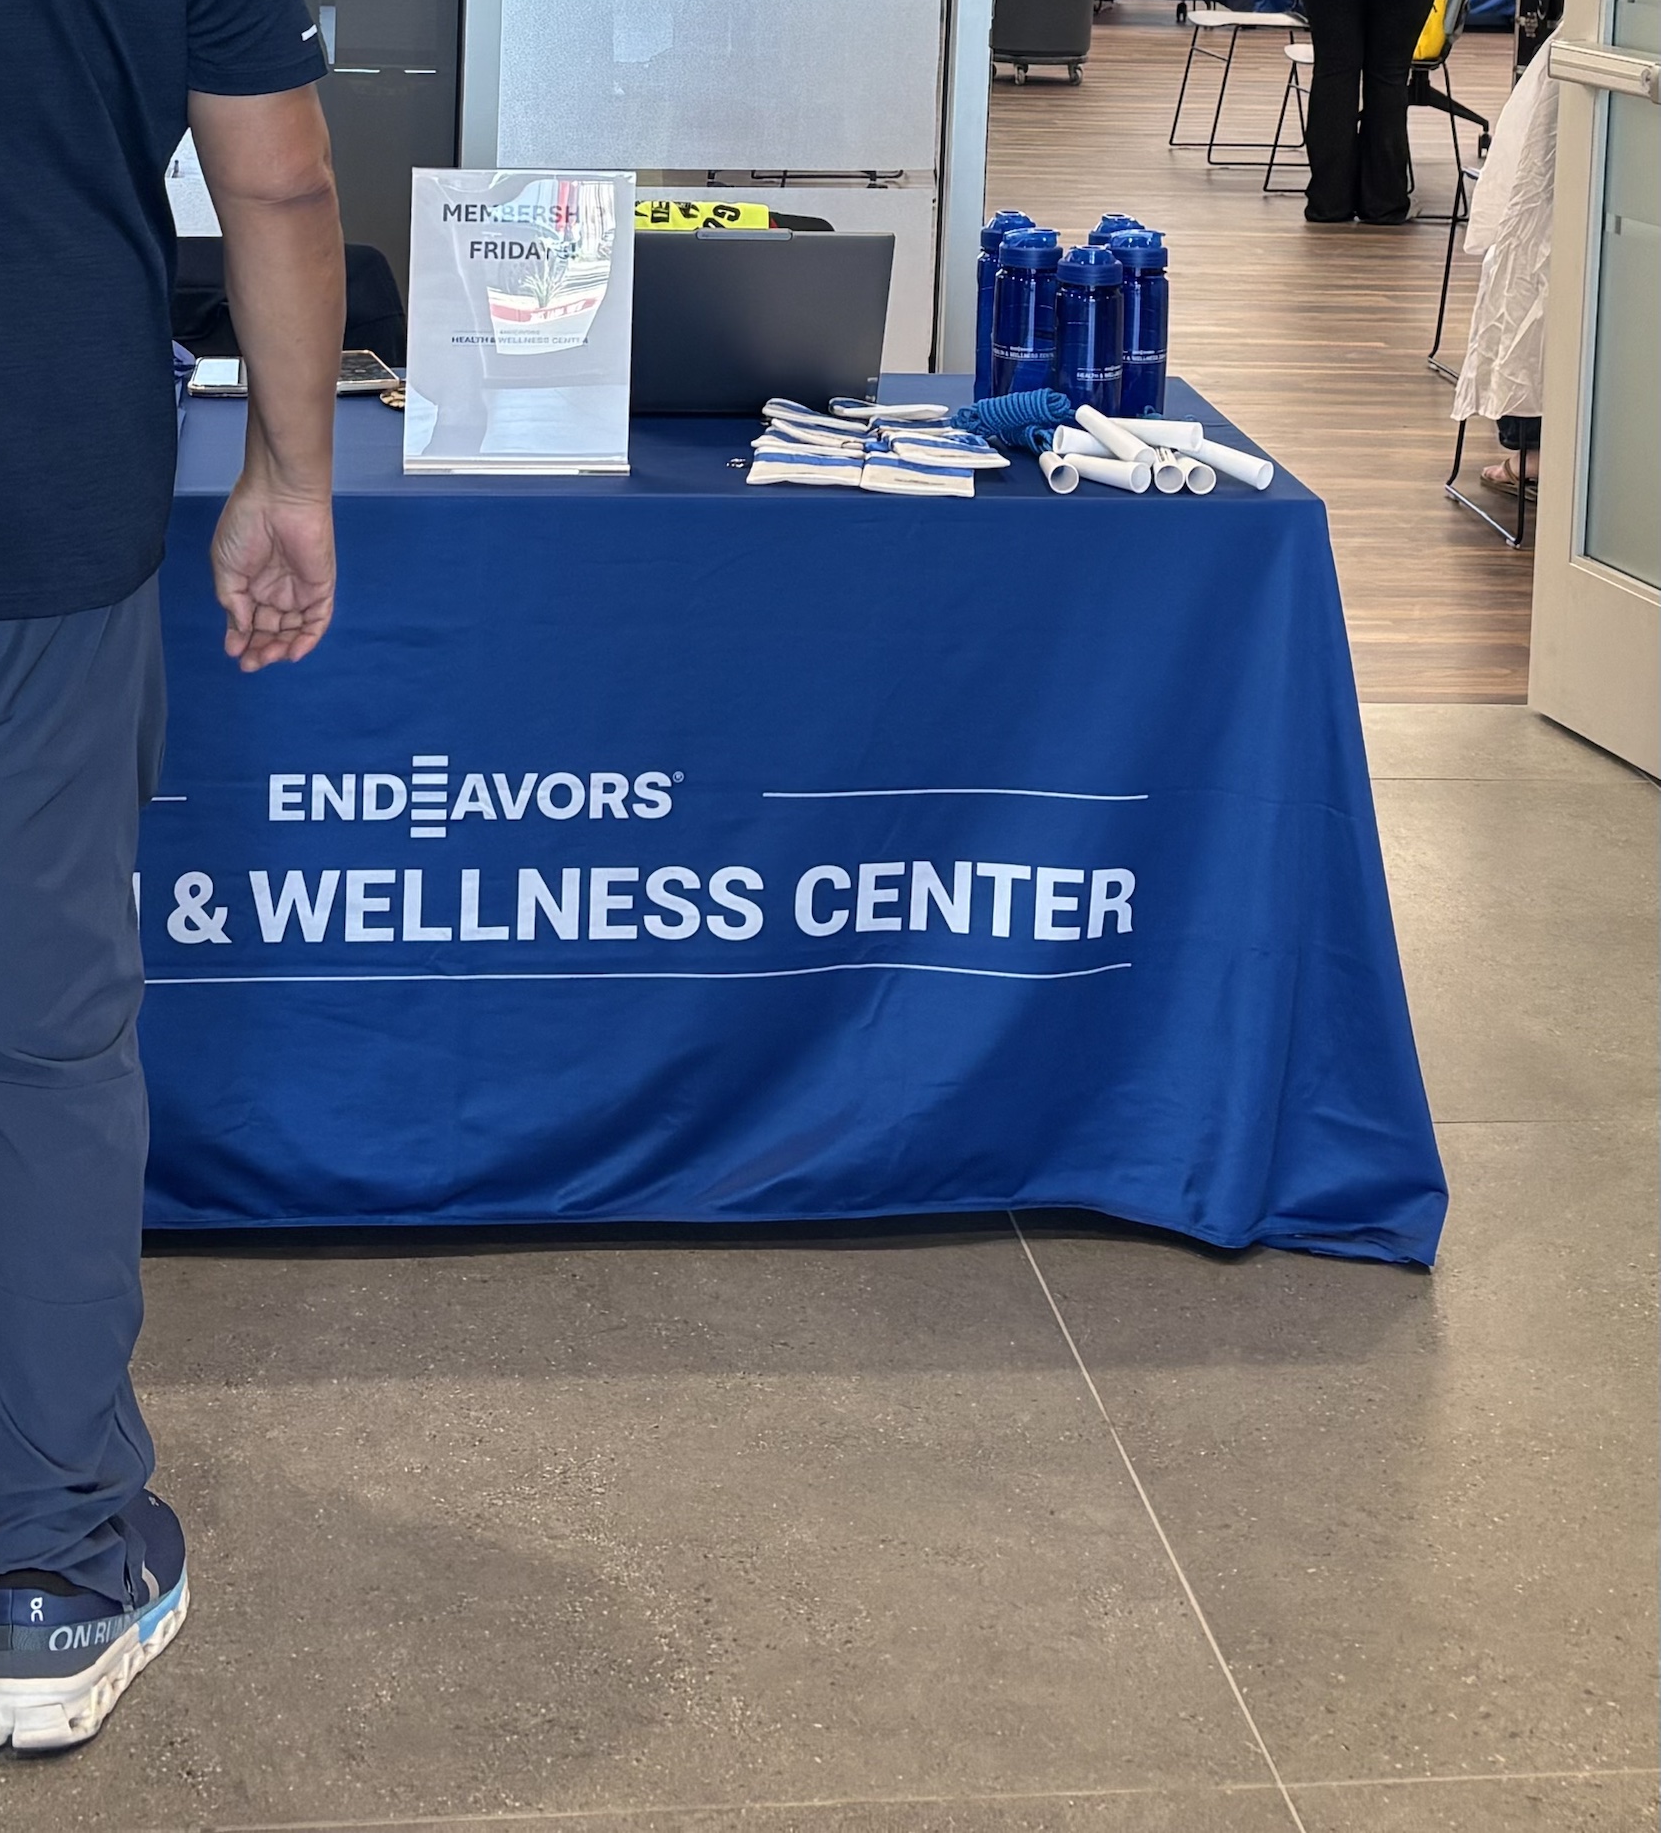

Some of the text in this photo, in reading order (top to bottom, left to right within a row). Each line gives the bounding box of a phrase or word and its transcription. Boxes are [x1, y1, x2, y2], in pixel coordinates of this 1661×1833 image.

[166, 871, 227, 944] &
[256, 868, 765, 942] WELLNESS
[795, 861, 1136, 941] CENTER
